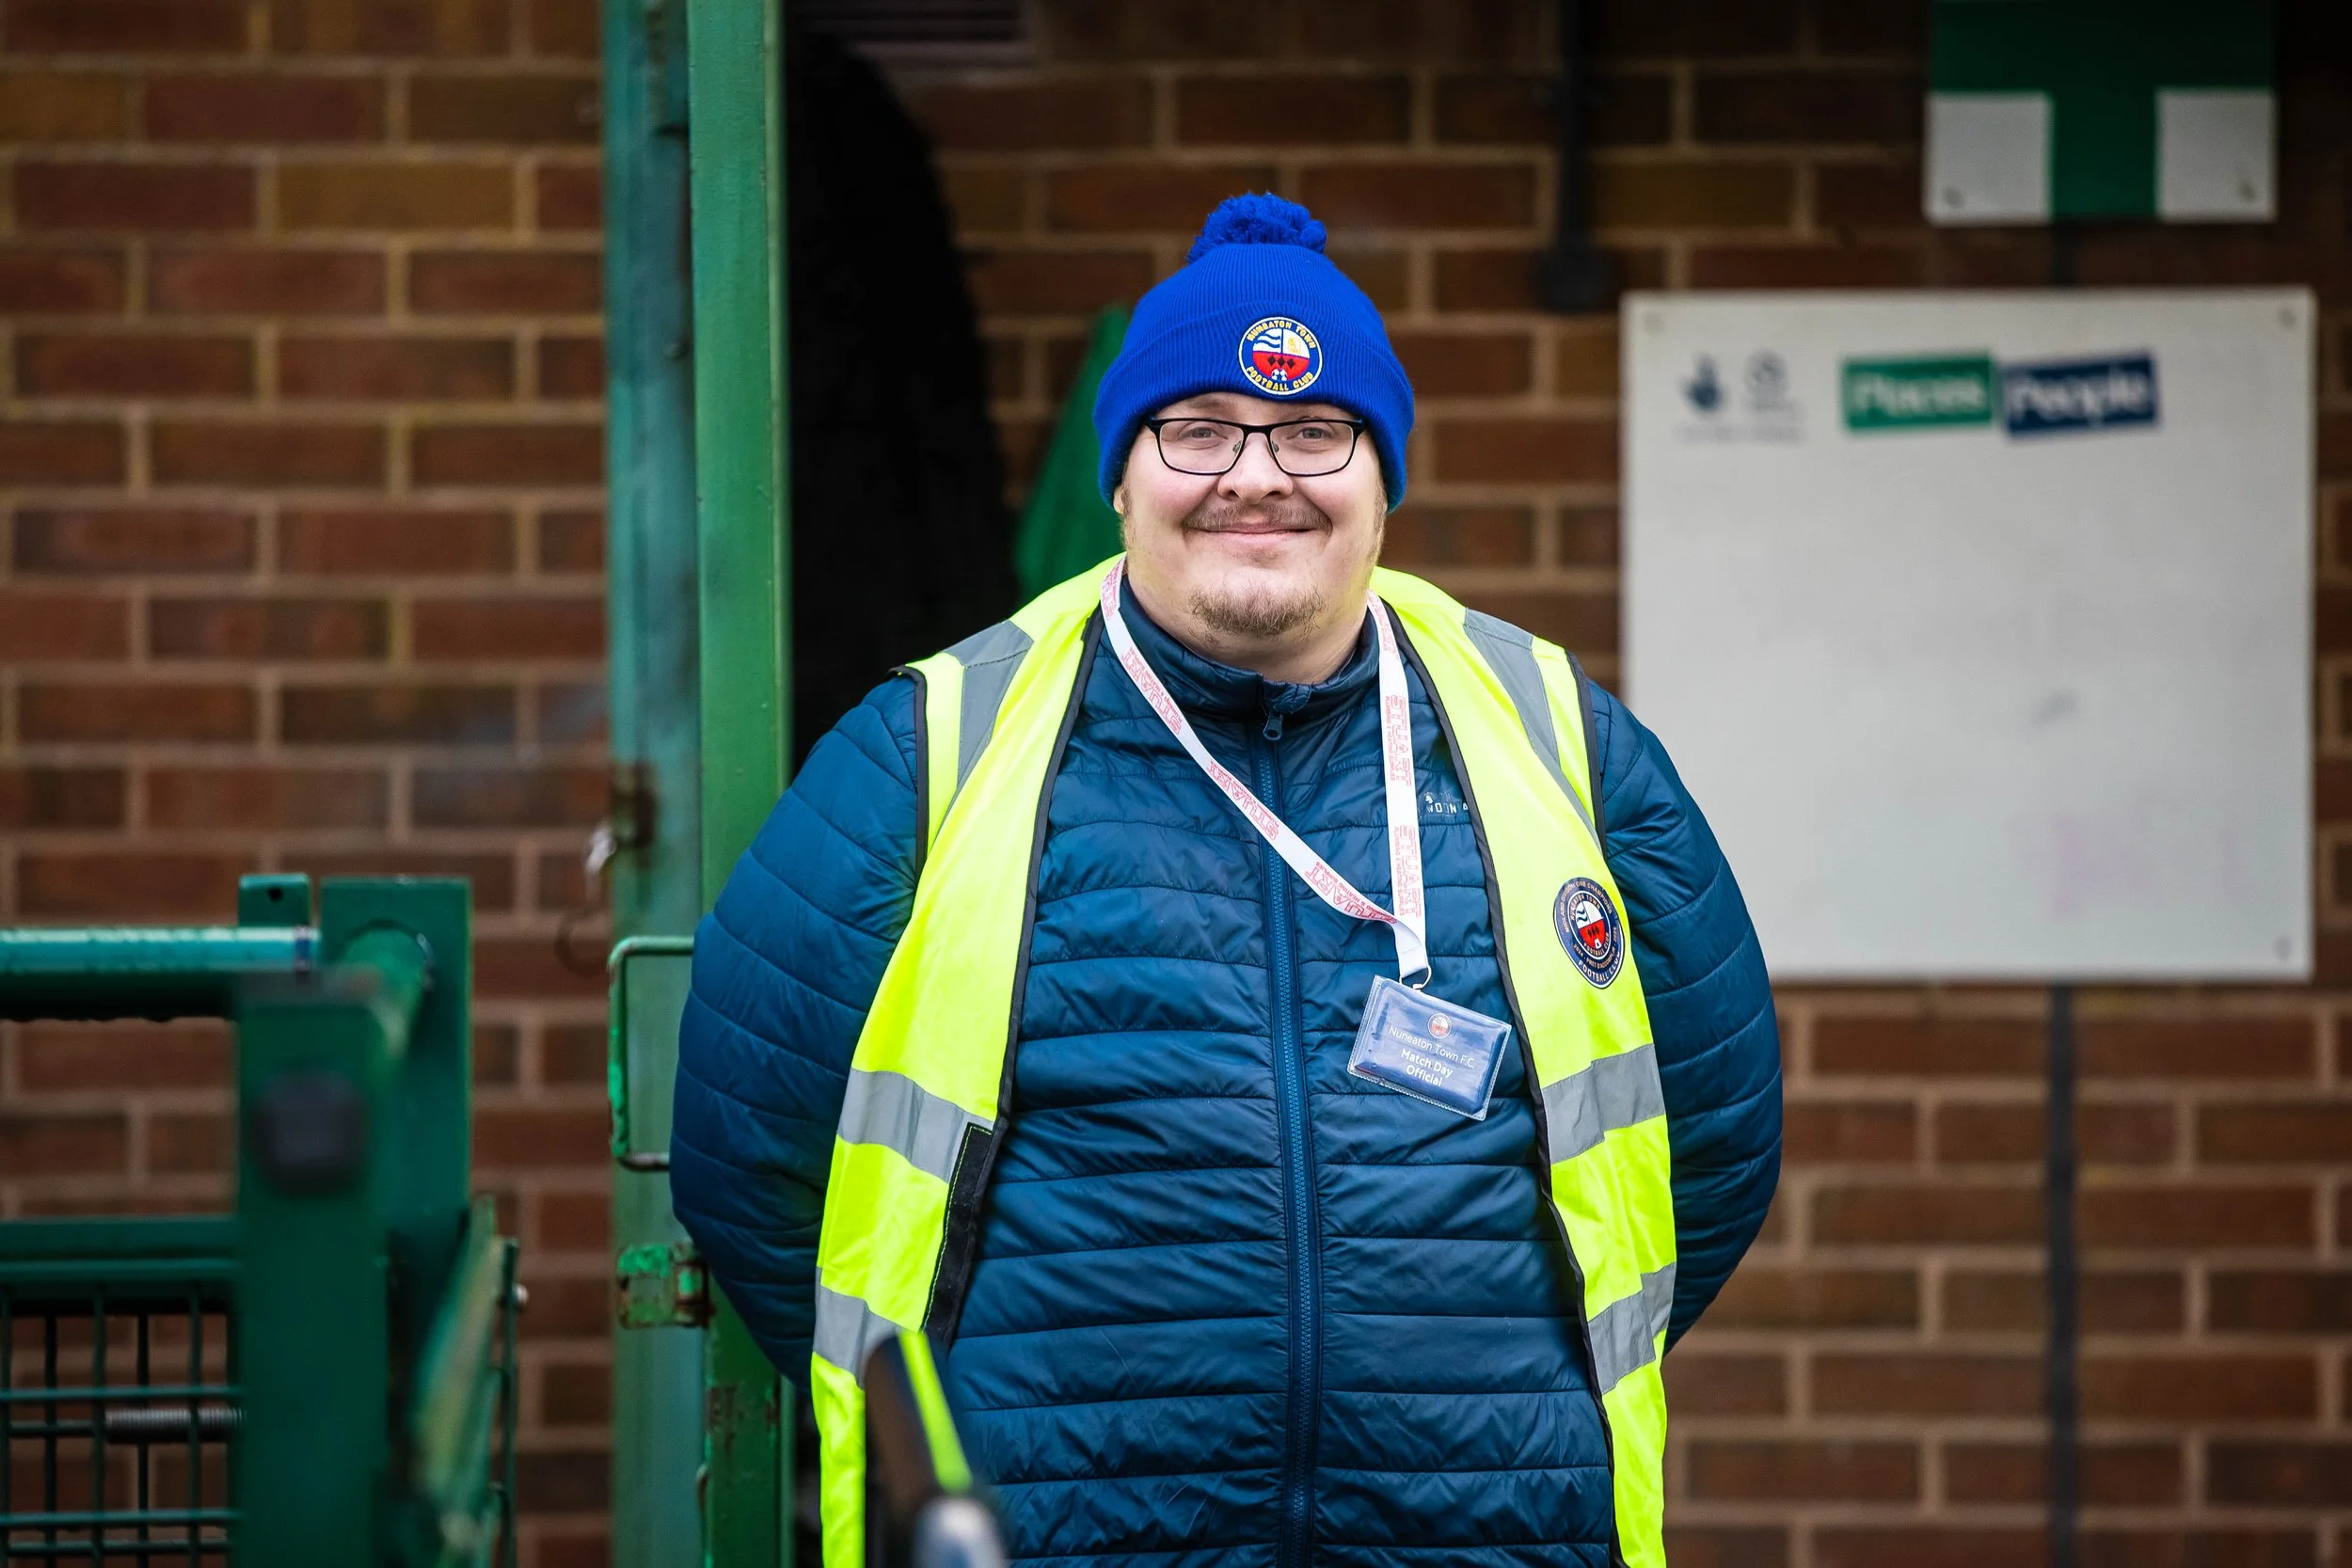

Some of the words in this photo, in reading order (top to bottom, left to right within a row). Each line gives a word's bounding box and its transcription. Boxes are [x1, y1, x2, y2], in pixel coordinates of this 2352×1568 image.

[1247, 320, 1292, 341] NUNEATON
[1295, 325, 1317, 348] TOWN
[1247, 366, 1289, 391] FOOTBALL
[1292, 372, 1313, 388] CLUB
[1121, 651, 1182, 735] STUART
[1391, 695, 1412, 786] STUART
[1206, 765, 1279, 841] STUART
[1315, 862, 1339, 882] SUPPLIES
[1400, 825, 1422, 917] STUART
[1338, 882, 1360, 903] HEATING
[1586, 895, 1601, 910] TOWN
[1587, 882, 1613, 914] CHAMPIONS
[1583, 942, 1605, 957] FOOTBALL
[1579, 959, 1609, 982] FOOTBALL
[1609, 951, 1620, 974] CLUB
[1388, 1024, 1433, 1051] Nuneaton
[1435, 1043, 1459, 1063] Town
[1459, 1053, 1475, 1069] F.C.
[1401, 1049, 1433, 1069] Match
[1432, 1060, 1453, 1078] Day
[1406, 1065, 1442, 1087] Official
